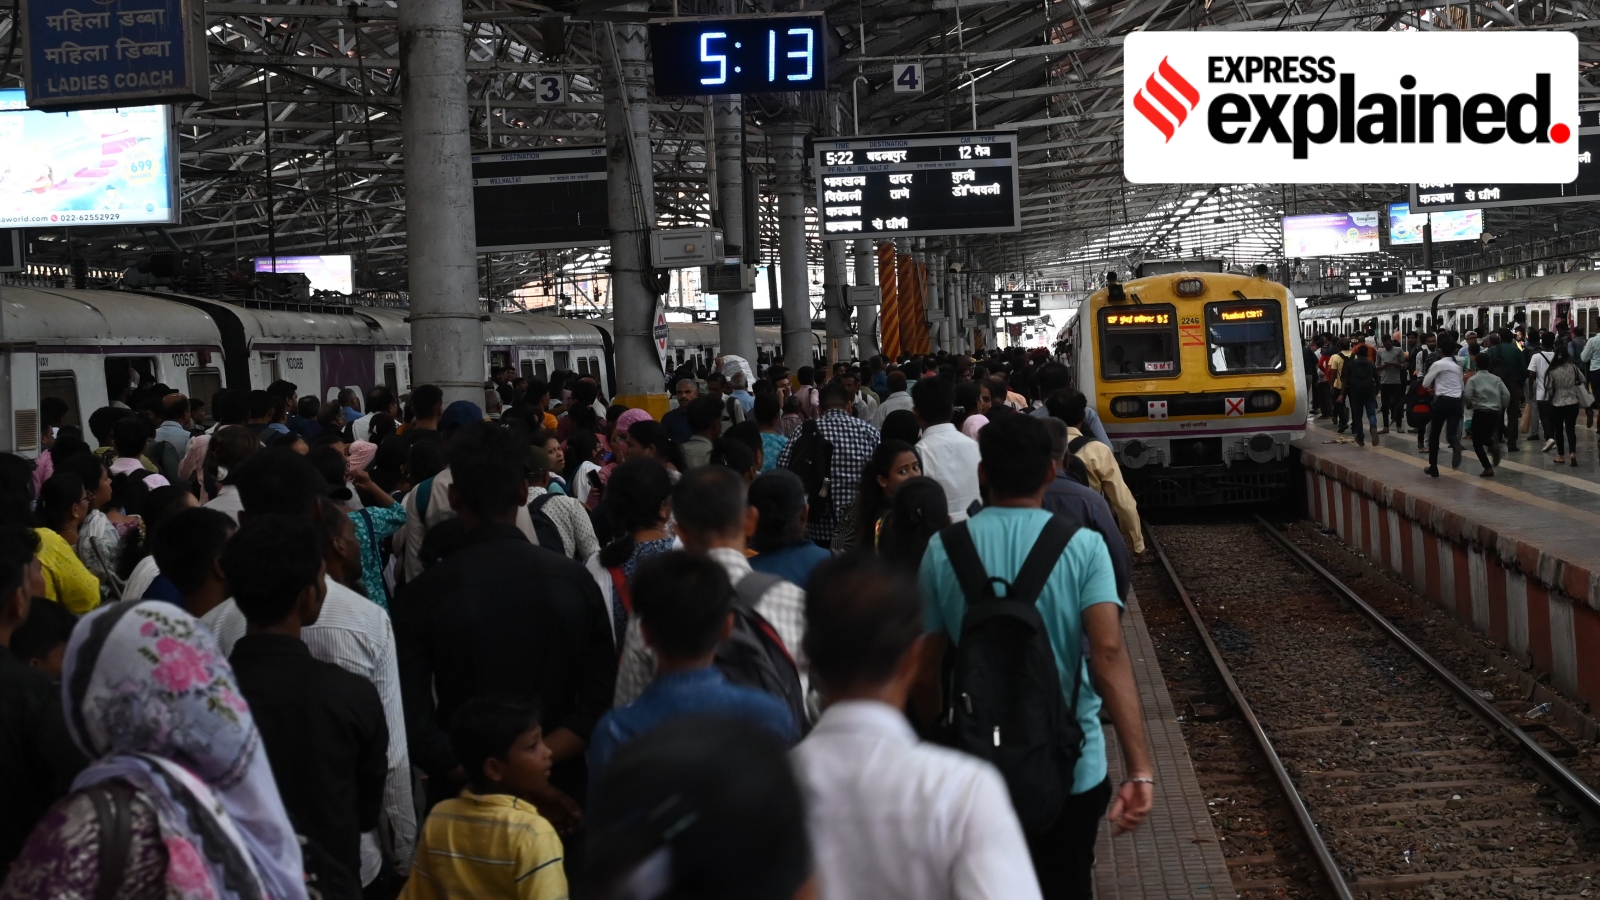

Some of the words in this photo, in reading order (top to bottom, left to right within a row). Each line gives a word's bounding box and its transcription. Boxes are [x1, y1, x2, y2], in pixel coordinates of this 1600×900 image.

[45, 8, 110, 32] महिला
[117, 9, 165, 27] डब्बा
[44, 41, 109, 65] महिला
[115, 38, 172, 60] डिब्बा
[700, 28, 814, 85] 5:13
[47, 74, 109, 93] LADIES
[114, 70, 173, 89] COACH
[896, 65, 918, 90] 4
[539, 77, 561, 103] 3
[826, 151, 854, 165] 5:22
[959, 146, 972, 159] 12
[131, 160, 152, 172] 699
[1419, 192, 1454, 204] कल्याण
[60, 213, 120, 222] 022-62552929
[1181, 317, 1199, 325] 2246
[171, 353, 194, 367] 1006C
